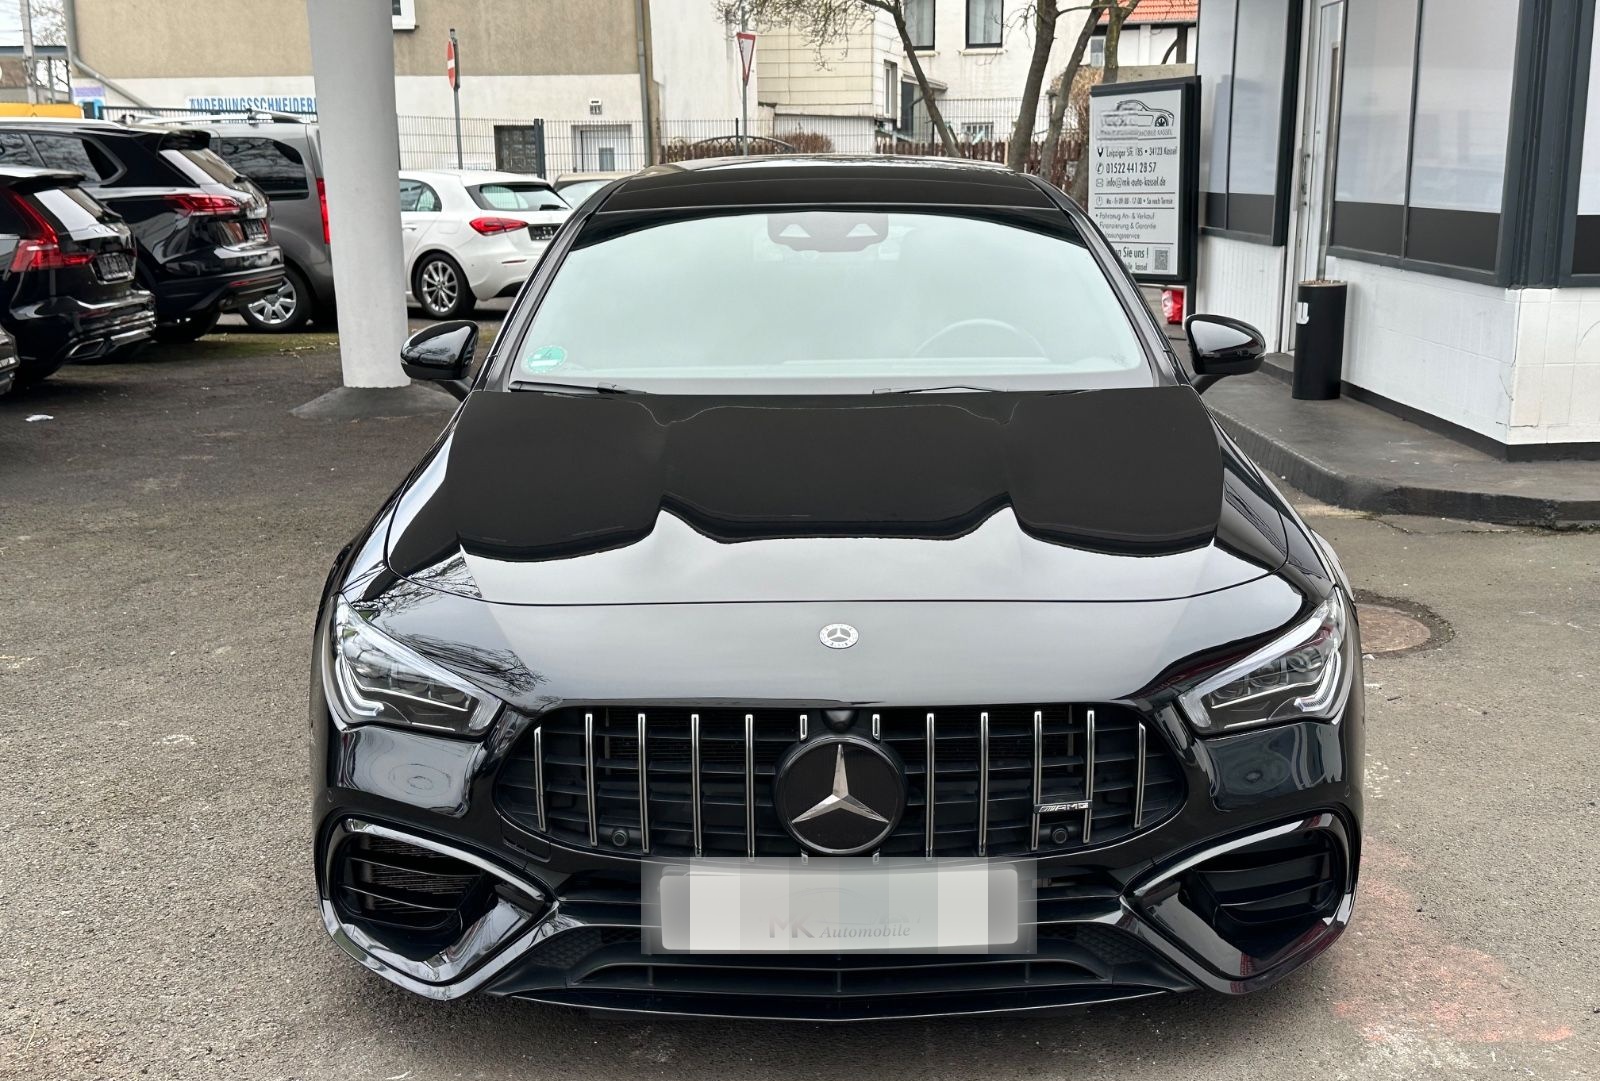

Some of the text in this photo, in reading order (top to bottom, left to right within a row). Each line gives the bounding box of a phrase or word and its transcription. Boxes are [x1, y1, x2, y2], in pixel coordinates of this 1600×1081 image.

[1106, 163, 1125, 174] 01522
[1127, 163, 1138, 173] 441
[1123, 247, 1133, 258] Sie
[1133, 249, 1145, 258] uns
[818, 923, 911, 938] Automobile
